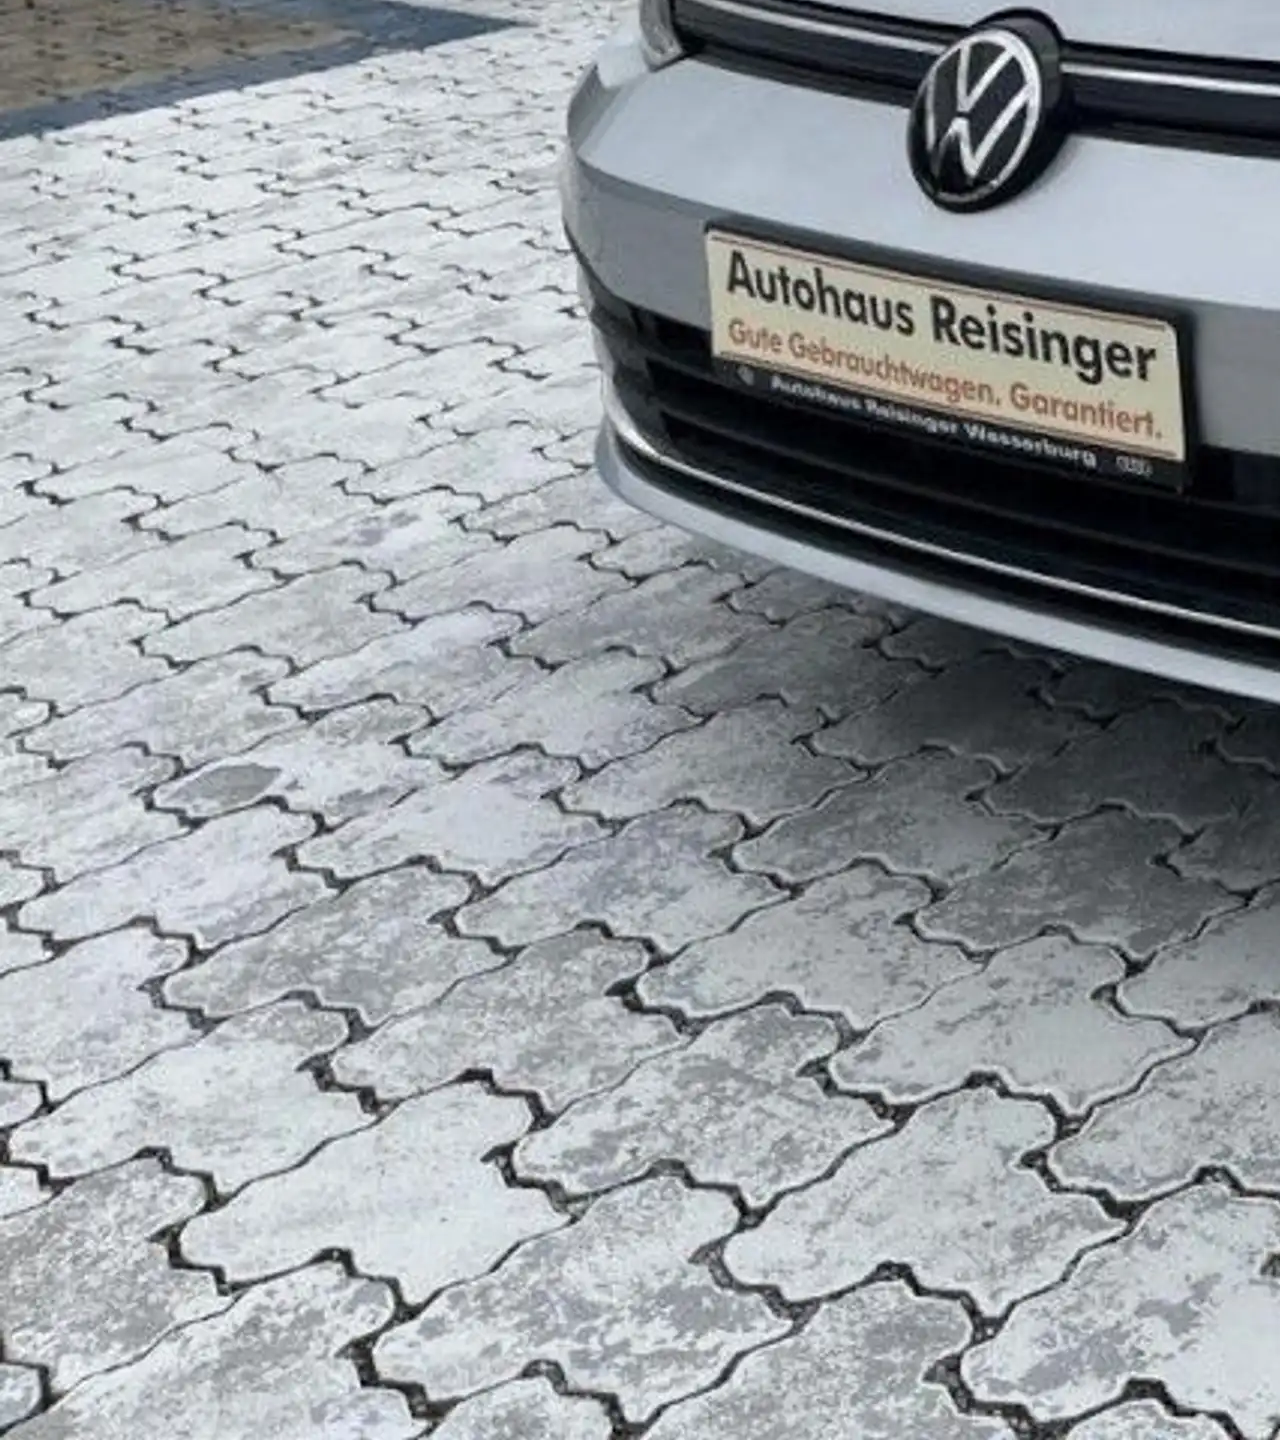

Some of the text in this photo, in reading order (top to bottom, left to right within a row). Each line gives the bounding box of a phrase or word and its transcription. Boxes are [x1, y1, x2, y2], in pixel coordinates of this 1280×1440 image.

[726, 249, 1158, 386] Autohaus Reisinger
[728, 317, 1163, 440] Gute Gebrauchtwagen. Garantiert.
[769, 374, 1098, 469] Autohaus Reisinger Wasserburg
